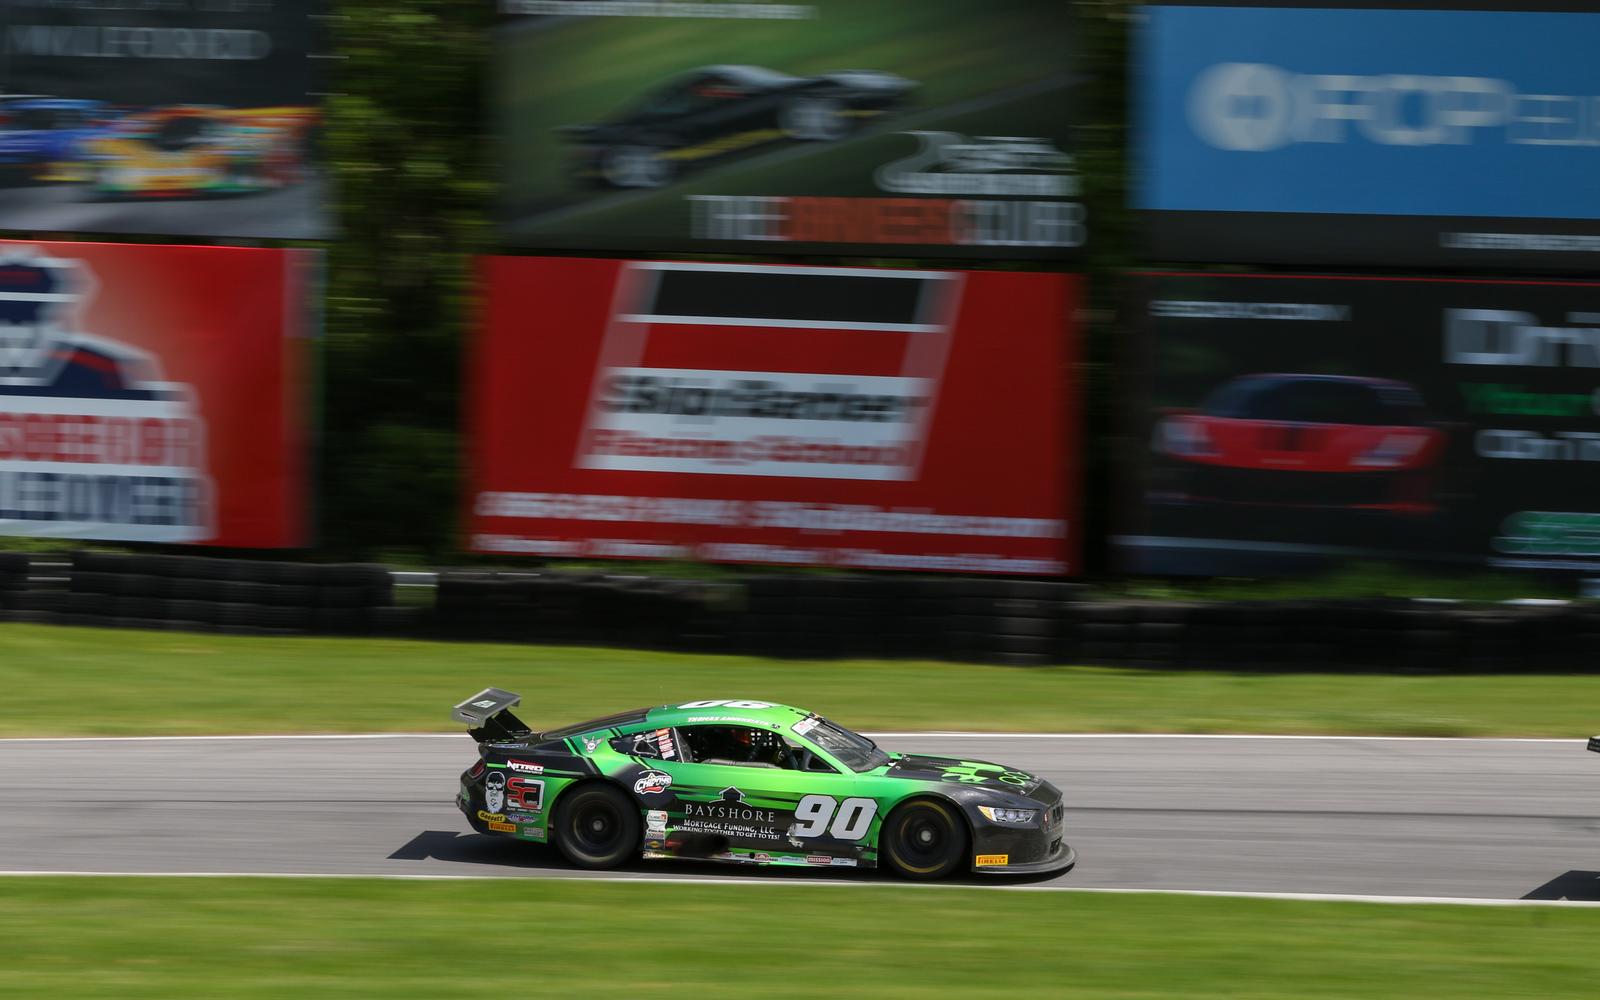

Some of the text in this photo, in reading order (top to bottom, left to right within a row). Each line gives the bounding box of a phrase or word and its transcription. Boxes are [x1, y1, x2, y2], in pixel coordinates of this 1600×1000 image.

[507, 760, 544, 772] NITRO
[685, 804, 775, 822] BAYSHORE
[794, 795, 878, 840] 90
[672, 825, 702, 833] WORKING
